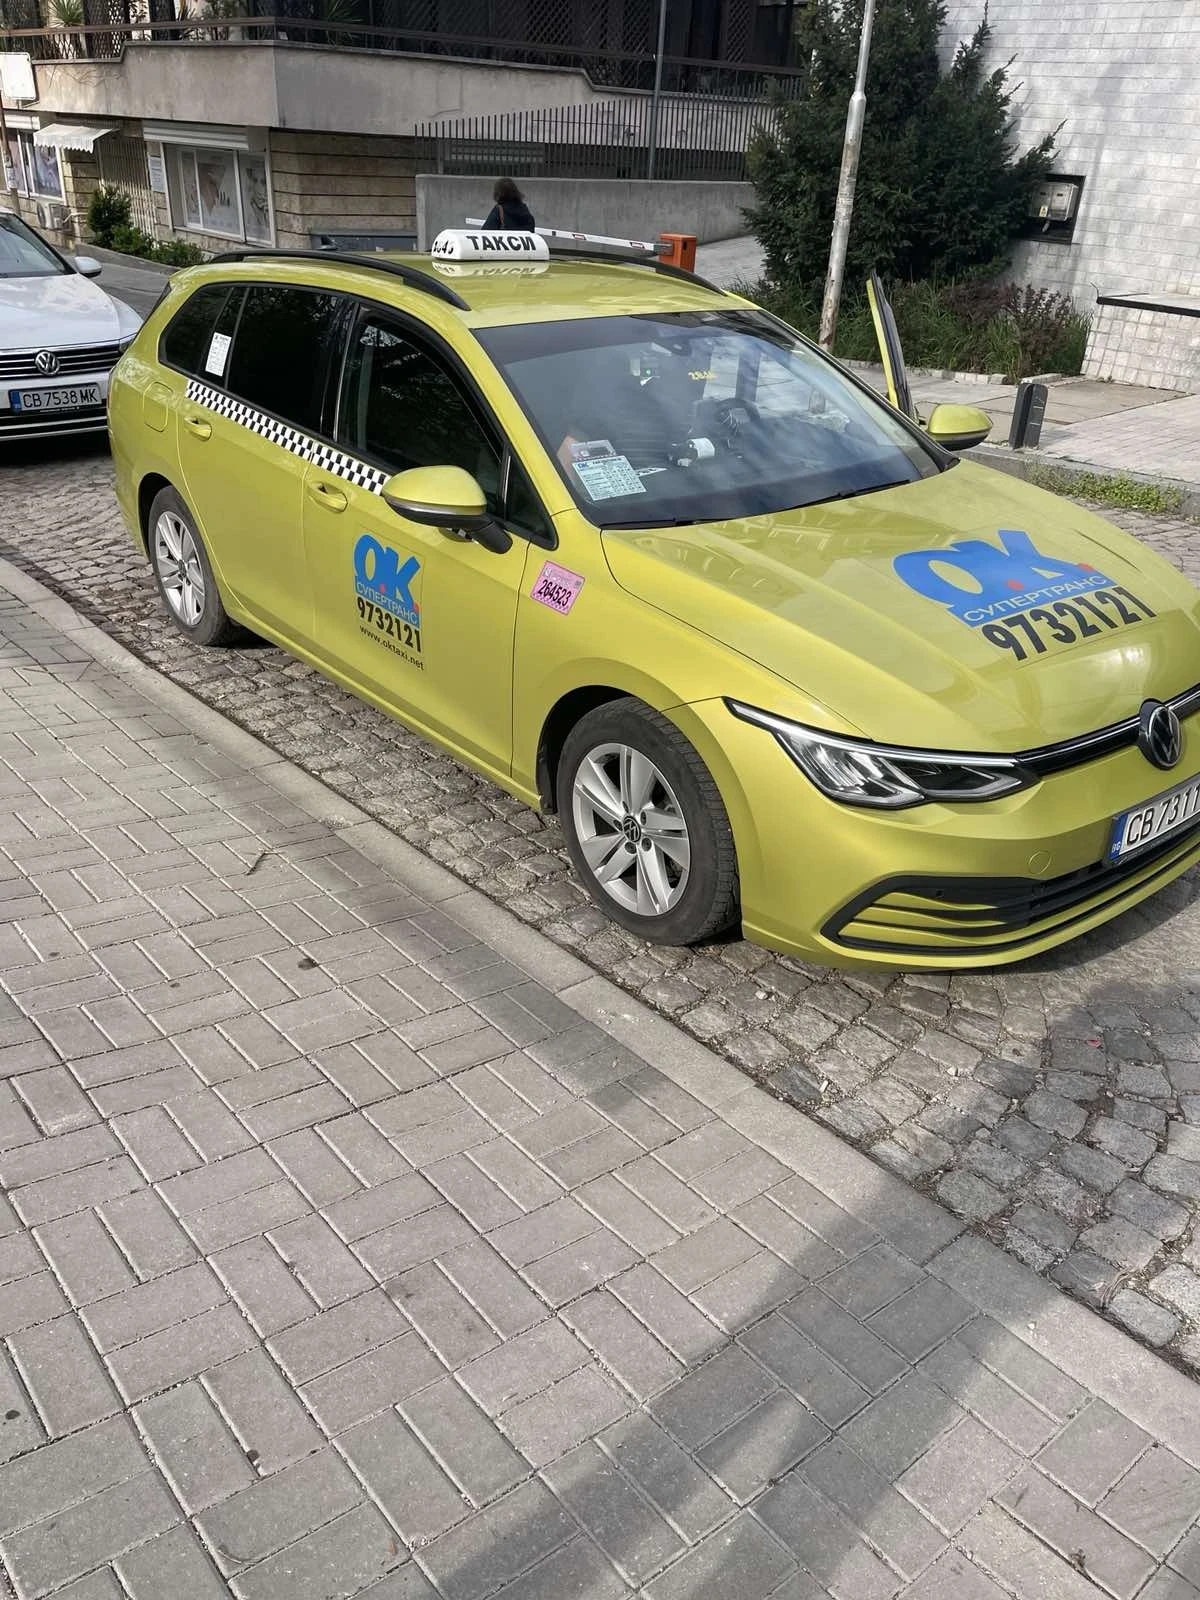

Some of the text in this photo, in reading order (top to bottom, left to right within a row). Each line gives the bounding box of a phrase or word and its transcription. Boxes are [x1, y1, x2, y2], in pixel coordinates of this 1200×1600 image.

[466, 235, 536, 251] ТАКСИ
[23, 388, 98, 408] CB 7538 MK
[356, 581, 418, 626] СУПЕРТРАНС
[537, 579, 572, 607] 264523
[963, 575, 1108, 622] СУПЕРТРАНС
[357, 597, 421, 653] 9732121
[981, 586, 1157, 661] 9732121
[360, 624, 424, 671] www.oktaxi.net
[1126, 806, 1155, 846] CB
